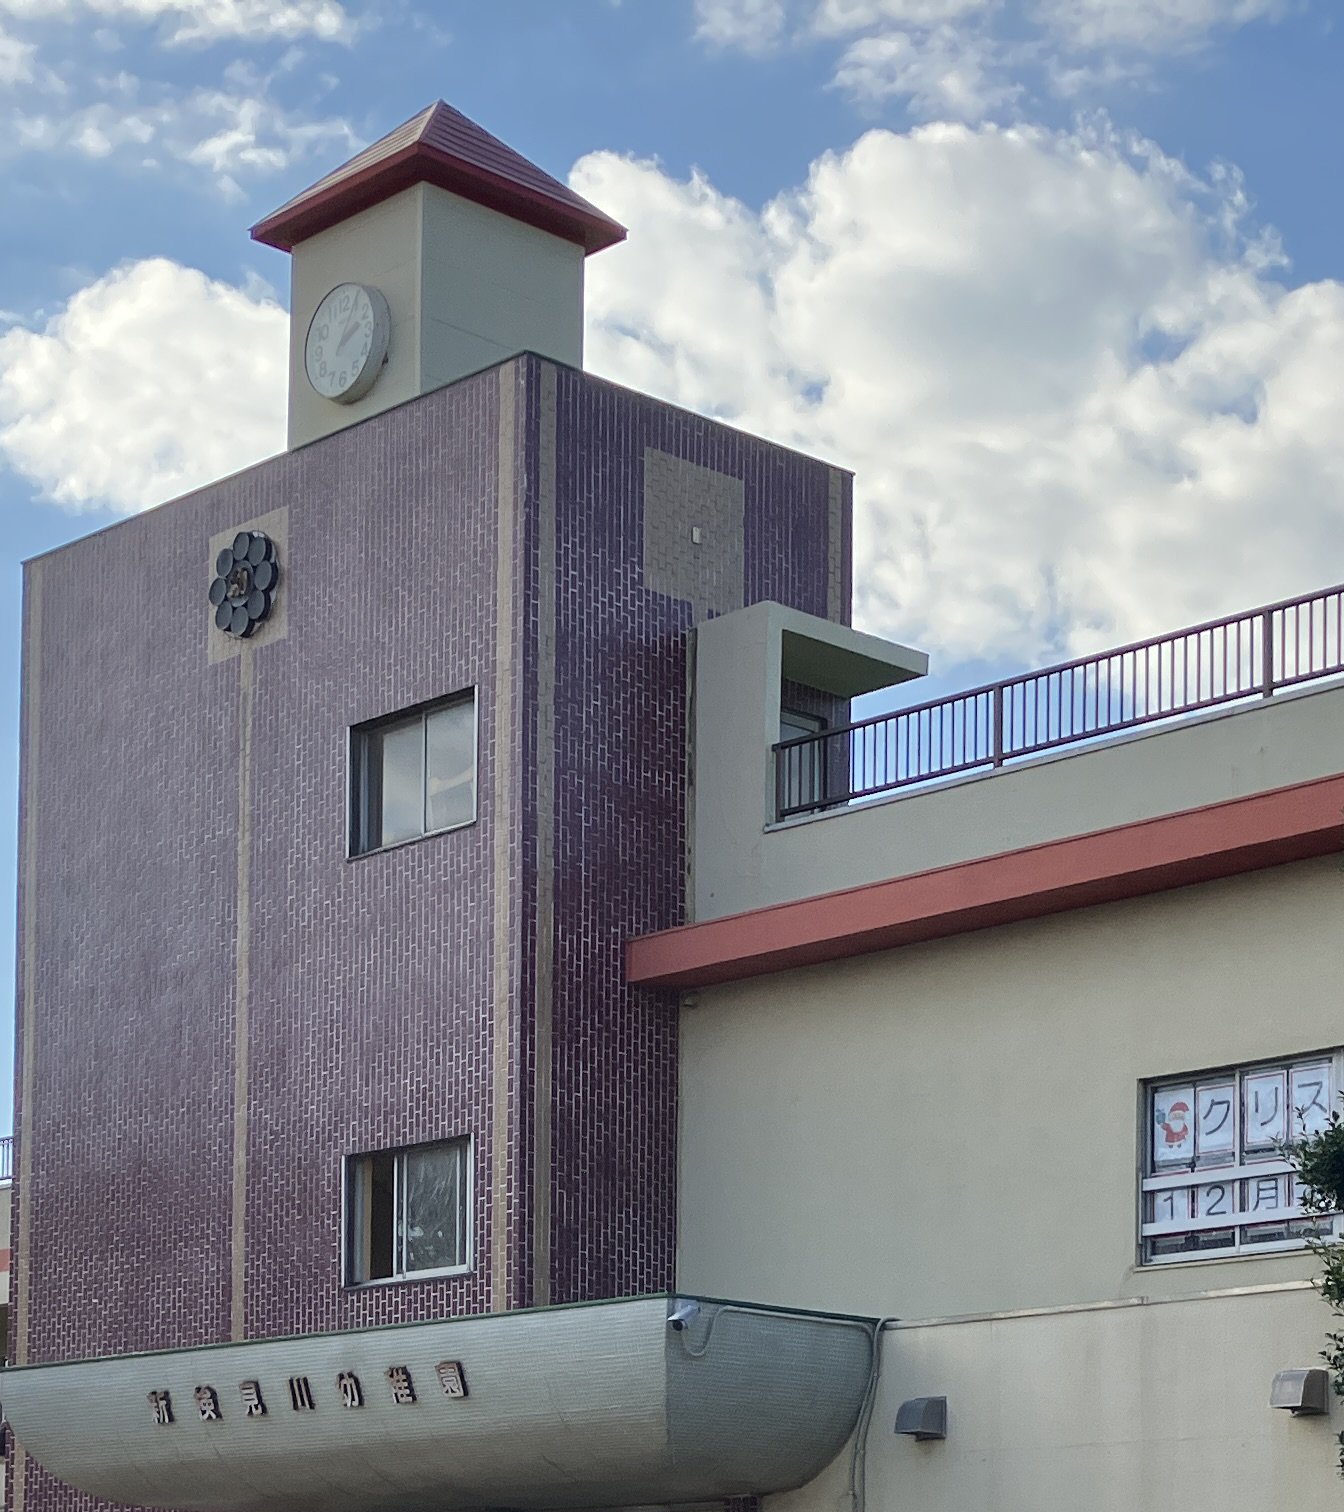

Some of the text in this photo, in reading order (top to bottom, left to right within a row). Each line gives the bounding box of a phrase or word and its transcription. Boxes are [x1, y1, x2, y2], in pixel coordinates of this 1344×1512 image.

[1202, 1079, 1329, 1137] クリス
[1162, 1177, 1282, 1222] 12月
[146, 1360, 471, 1425] 新検見川幼稚園
